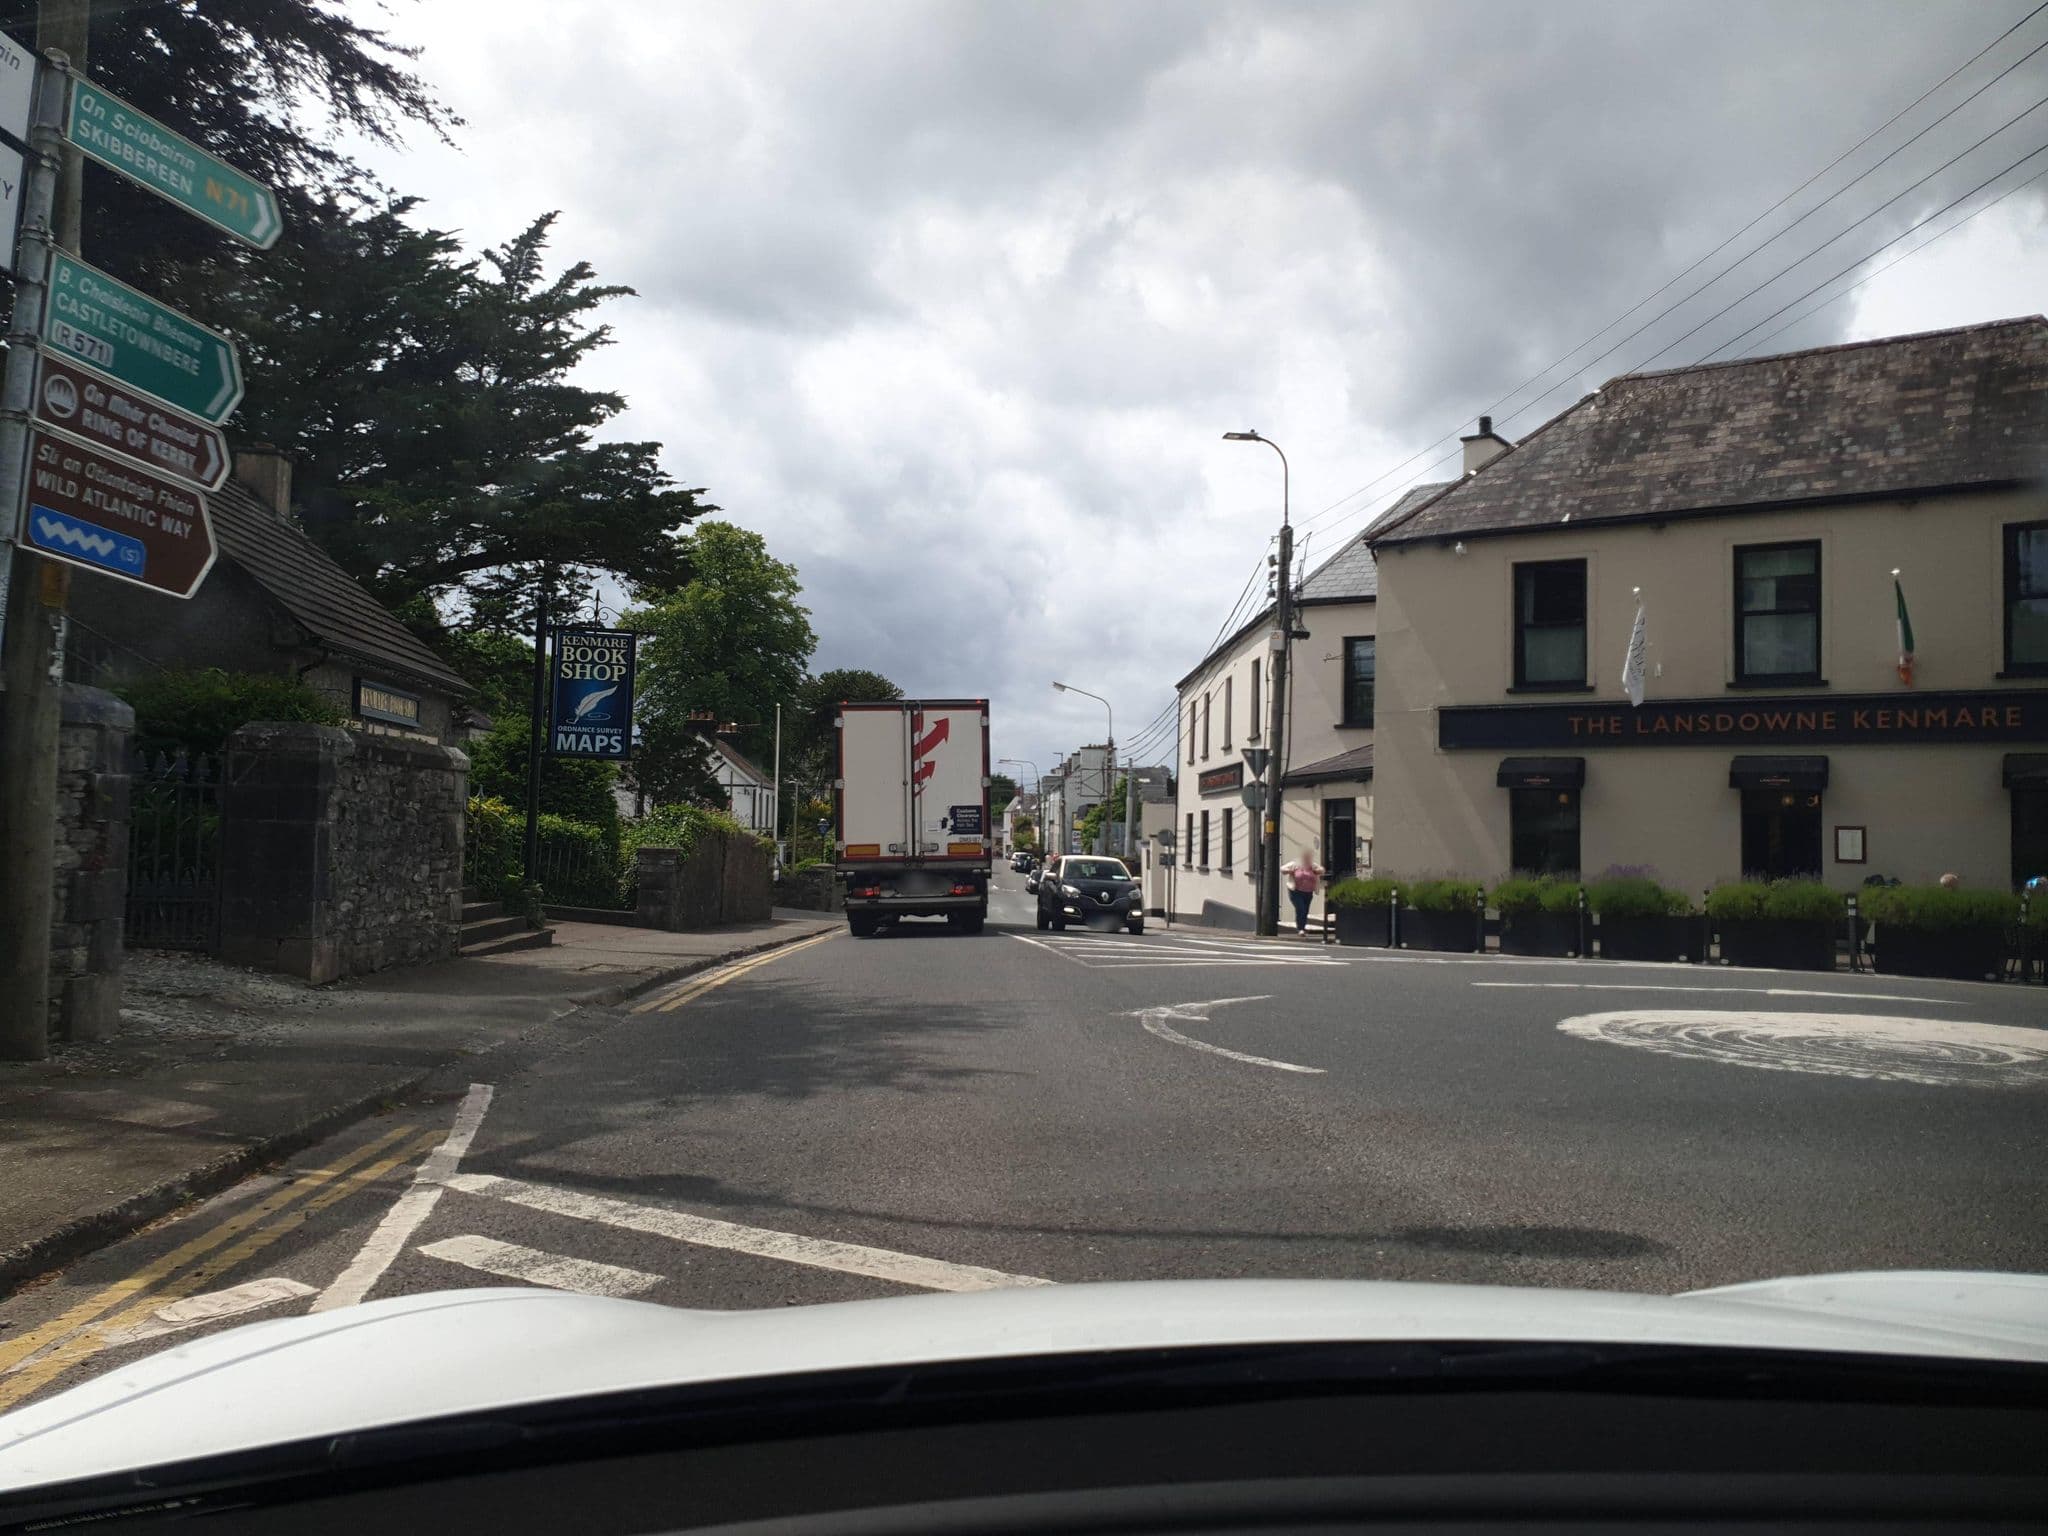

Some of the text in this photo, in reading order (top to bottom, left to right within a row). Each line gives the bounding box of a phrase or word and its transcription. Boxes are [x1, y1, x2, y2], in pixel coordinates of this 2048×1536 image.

[79, 119, 193, 195] SKIBBEREEN
[206, 176, 249, 217] N71
[56, 292, 201, 377] CASTLETOWNBERE
[82, 408, 197, 471] RING OF KERRY
[36, 468, 193, 540] WILD ATLANTIC WAY
[561, 635, 628, 649] KENMARE
[561, 646, 628, 665] BOOK
[560, 662, 627, 682] SHOP
[557, 725, 623, 735] ORDNANCE SURVEY
[1568, 705, 2023, 735] THE LANSDOWNE KENMARE
[556, 733, 623, 754] MAPS
